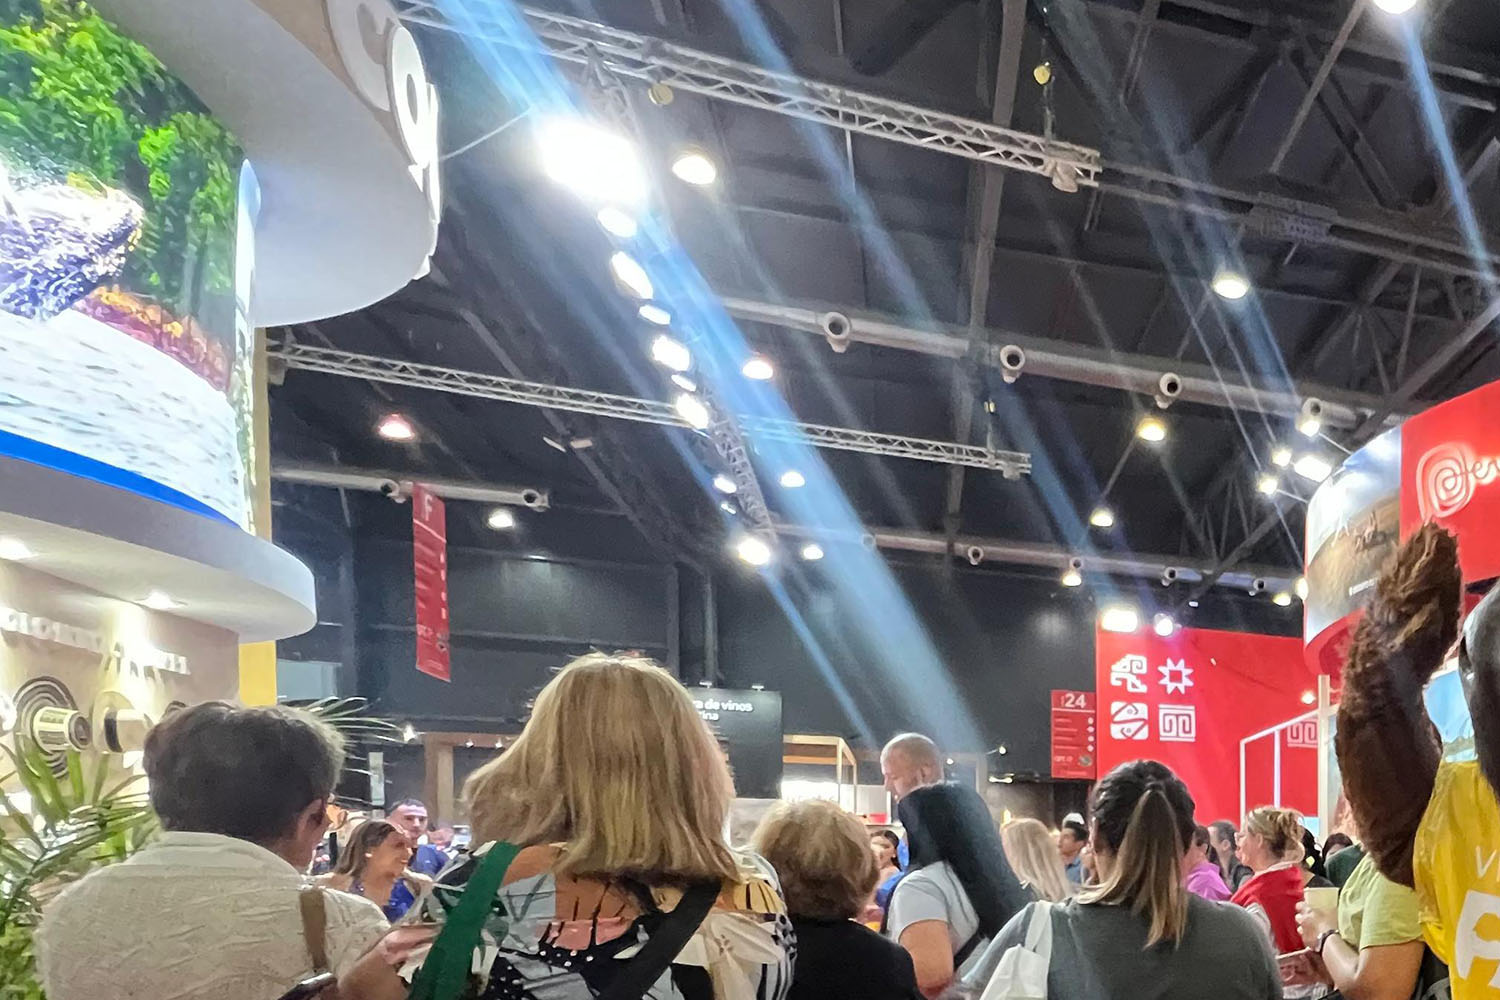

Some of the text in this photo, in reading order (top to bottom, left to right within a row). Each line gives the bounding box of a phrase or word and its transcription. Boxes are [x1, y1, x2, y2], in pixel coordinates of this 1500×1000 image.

[704, 698, 720, 710] de
[721, 700, 753, 712] vinos
[1064, 693, 1087, 709] 24
